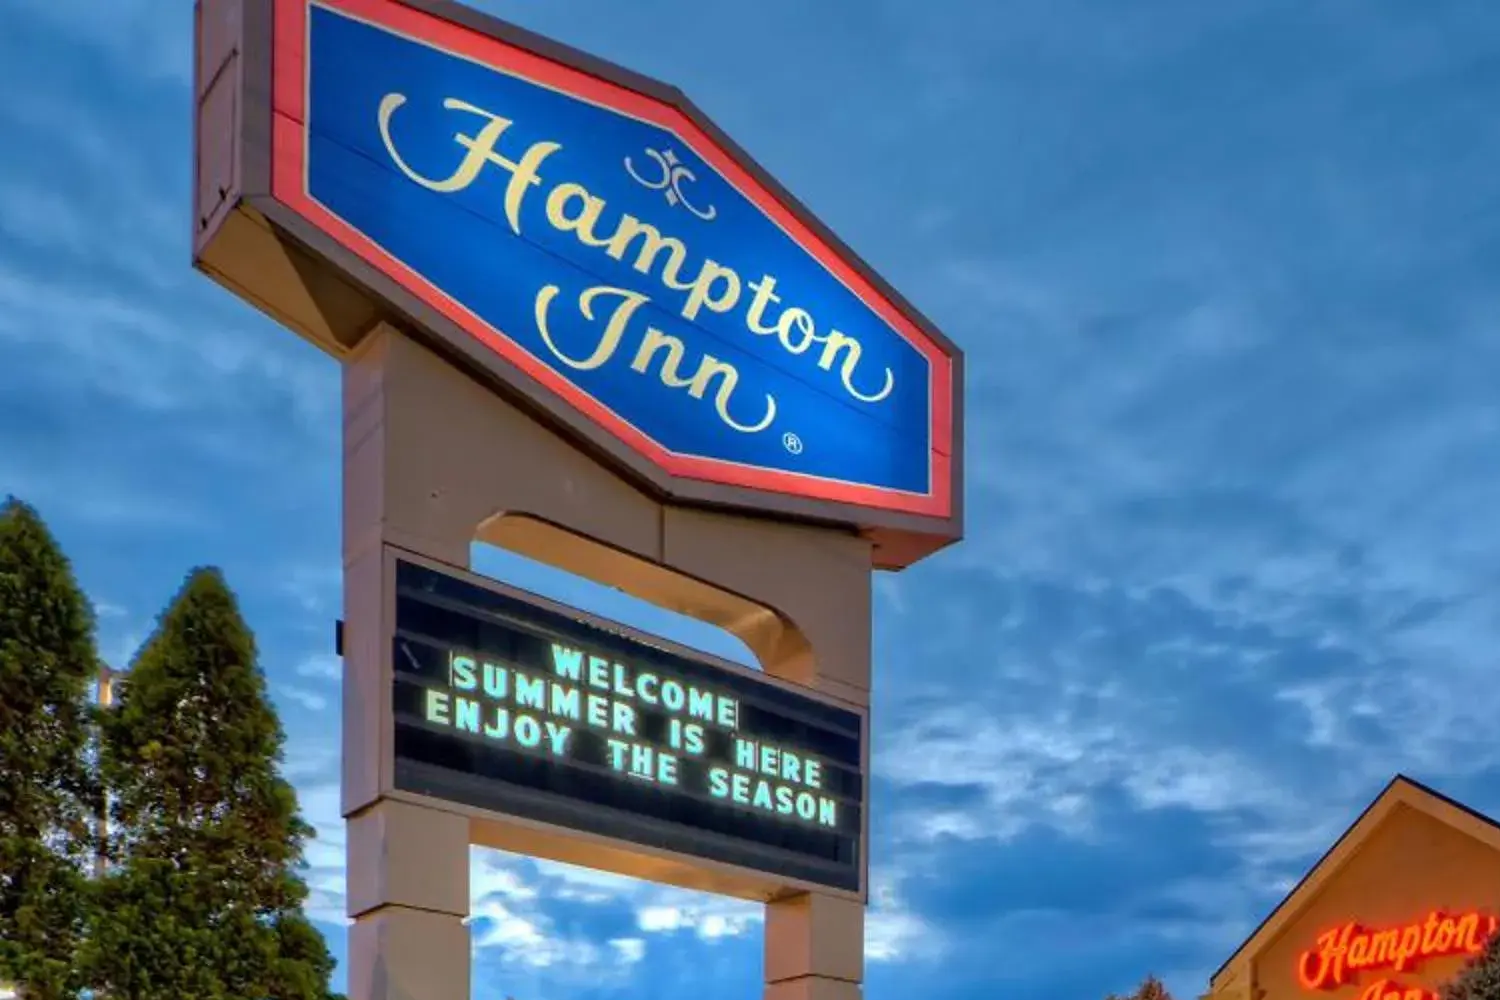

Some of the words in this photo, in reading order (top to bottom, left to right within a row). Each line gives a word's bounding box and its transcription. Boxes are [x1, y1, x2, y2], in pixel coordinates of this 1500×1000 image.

[377, 92, 894, 403] Hampton
[534, 284, 777, 434] Inn
[451, 656, 637, 737] SUMMER
[669, 719, 705, 755] IS
[735, 738, 822, 789] HERE
[551, 643, 737, 727] WELCOME
[425, 690, 571, 756] ENJOY
[608, 739, 679, 786] THE
[708, 768, 837, 828] SEASON
[1299, 911, 1496, 990] Hampton
